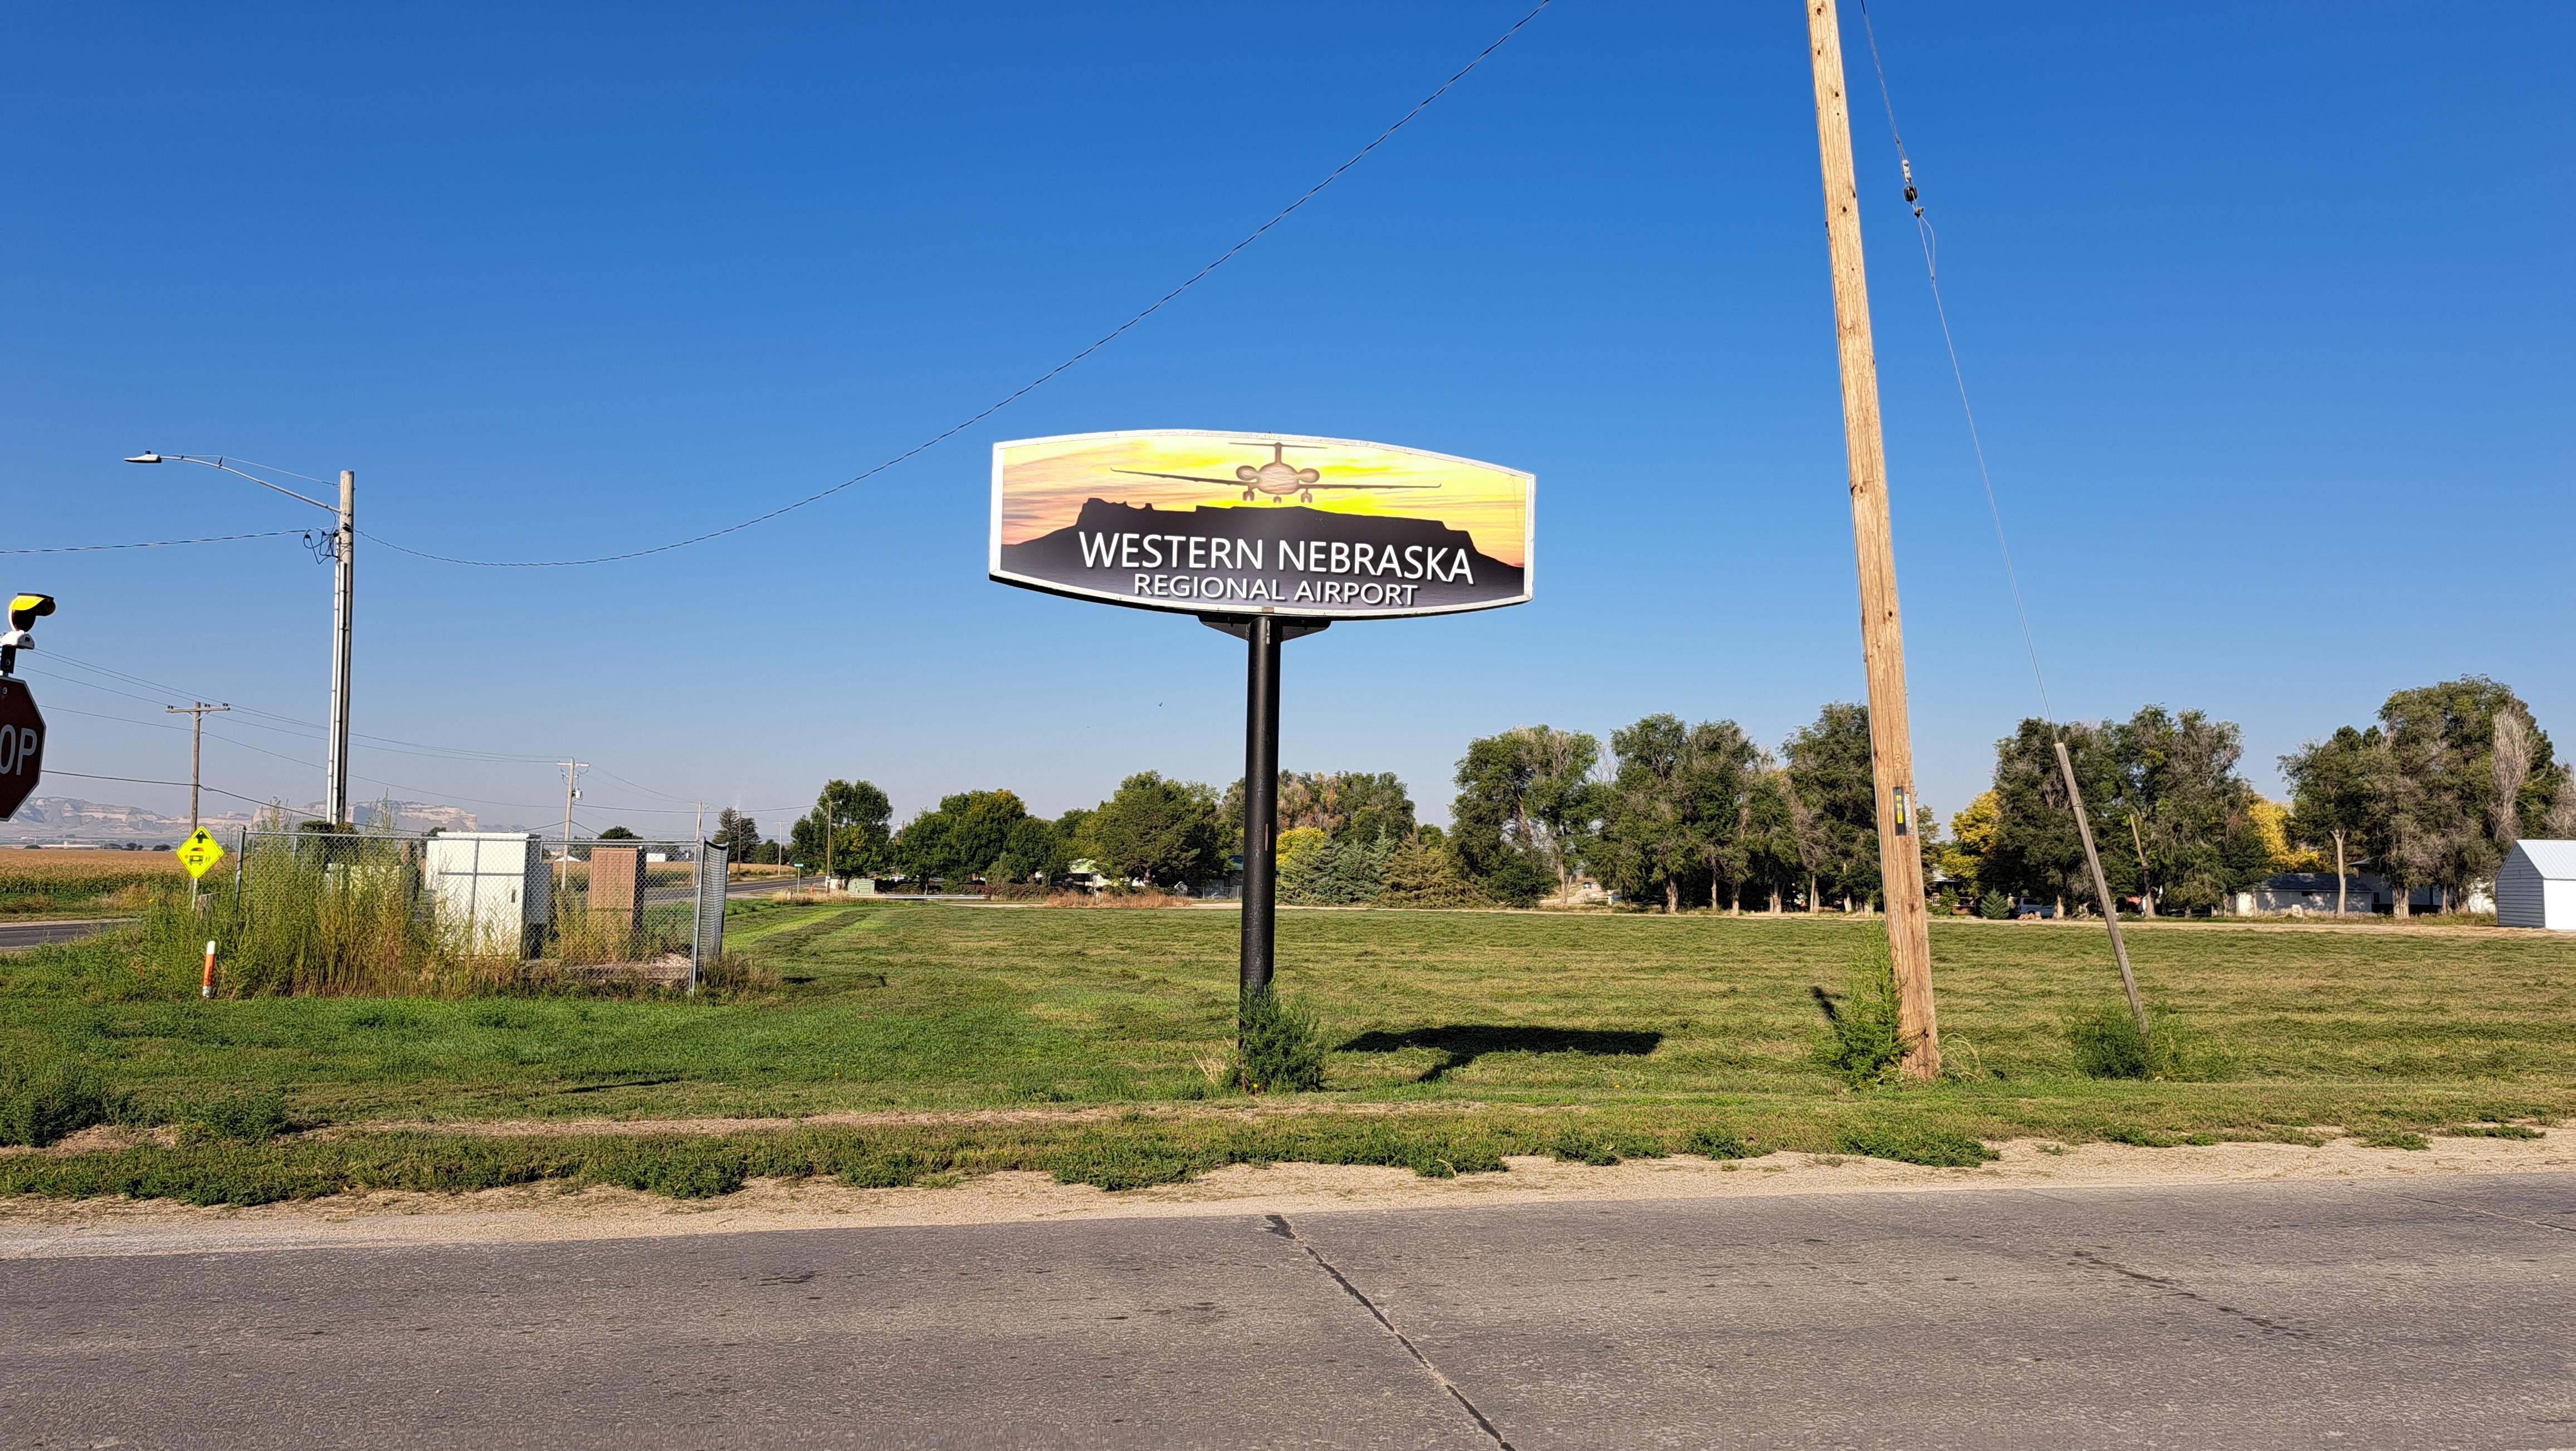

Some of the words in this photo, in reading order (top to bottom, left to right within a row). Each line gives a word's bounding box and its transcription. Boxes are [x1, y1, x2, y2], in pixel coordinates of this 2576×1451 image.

[1079, 532, 1262, 569] WESTERN
[1279, 540, 1474, 584] NEBRASKA
[1134, 573, 1285, 600] REGIONAL
[1294, 581, 1418, 605] AIRPORT
